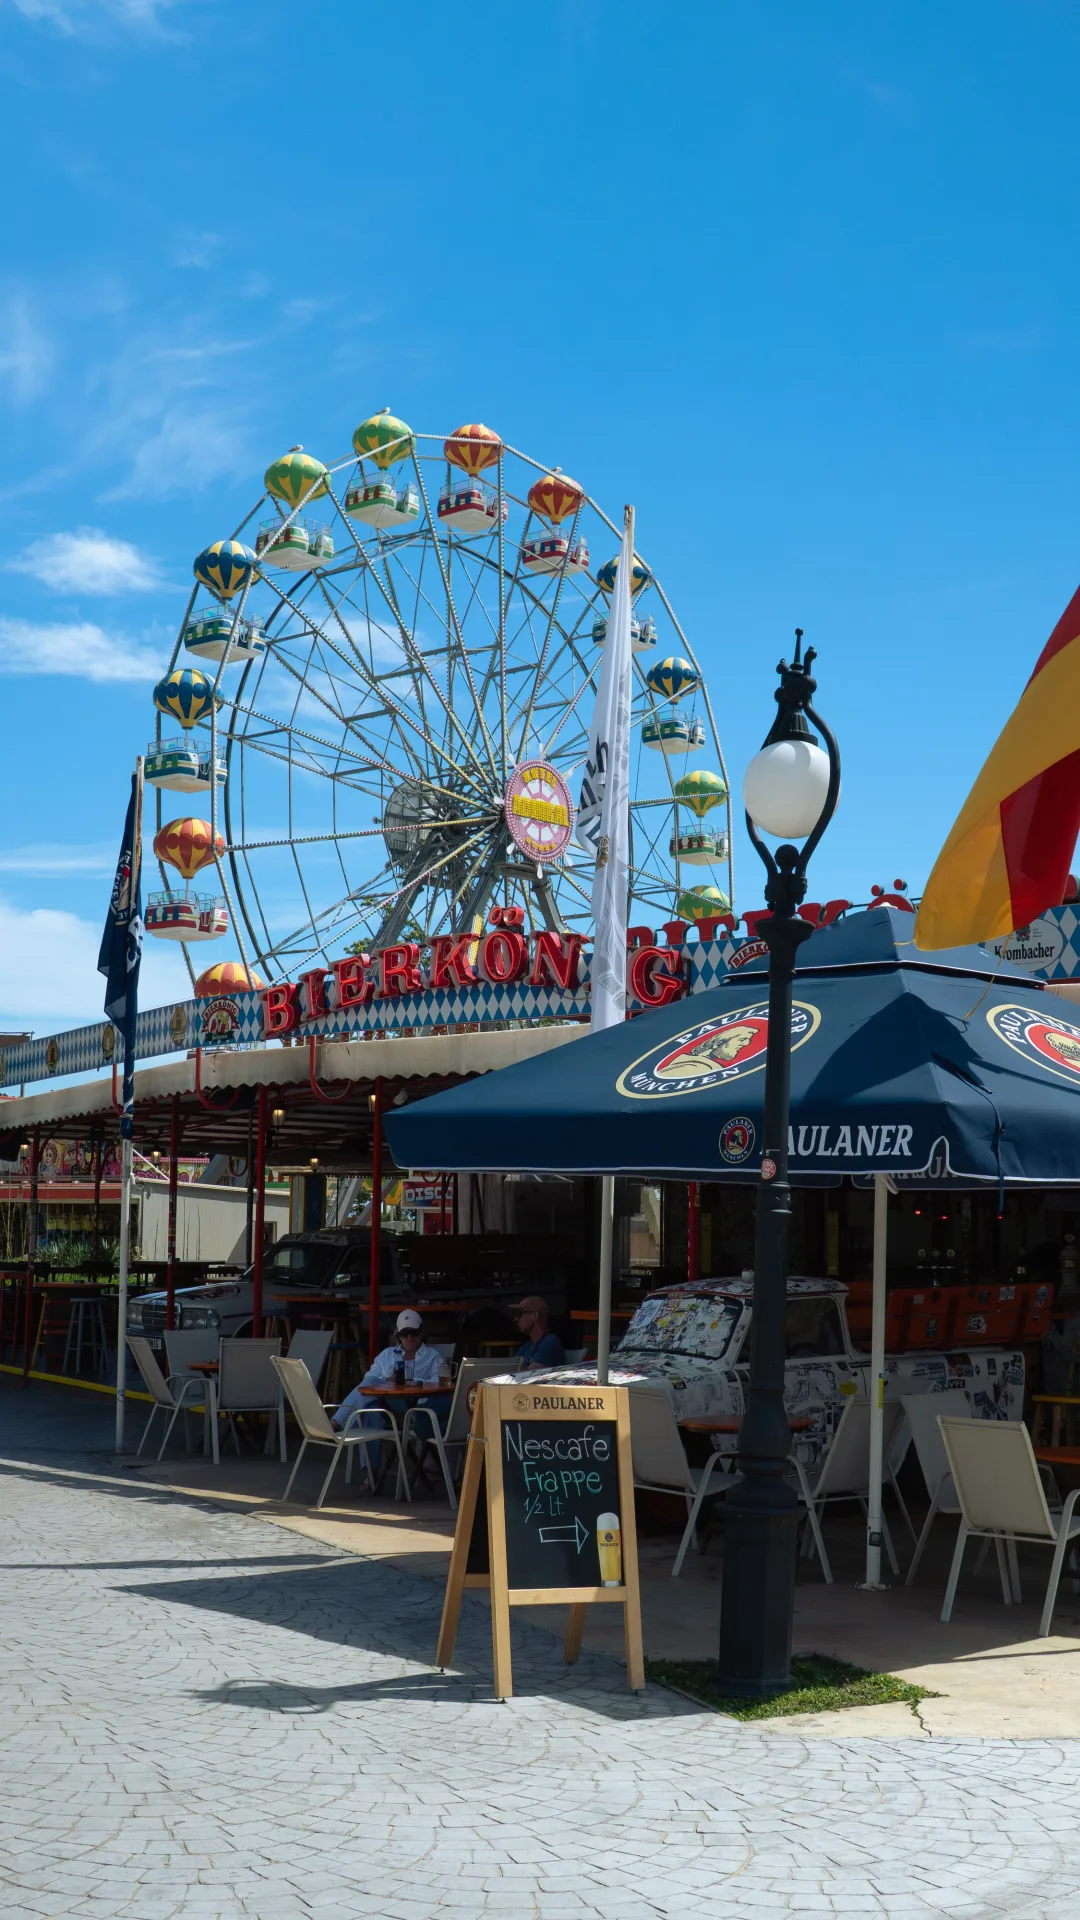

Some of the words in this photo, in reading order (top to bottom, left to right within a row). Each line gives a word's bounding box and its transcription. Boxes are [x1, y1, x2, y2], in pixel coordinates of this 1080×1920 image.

[260, 906, 690, 1041] BIERKÖNG
[999, 1011, 1080, 1045] PAULANE
[630, 1066, 740, 1092] MÜNCHEN
[759, 1124, 914, 1157] AULANER
[532, 1396, 605, 1410] PAULANER
[504, 1422, 610, 1462] Nescafe
[522, 1461, 603, 1499] Frappe
